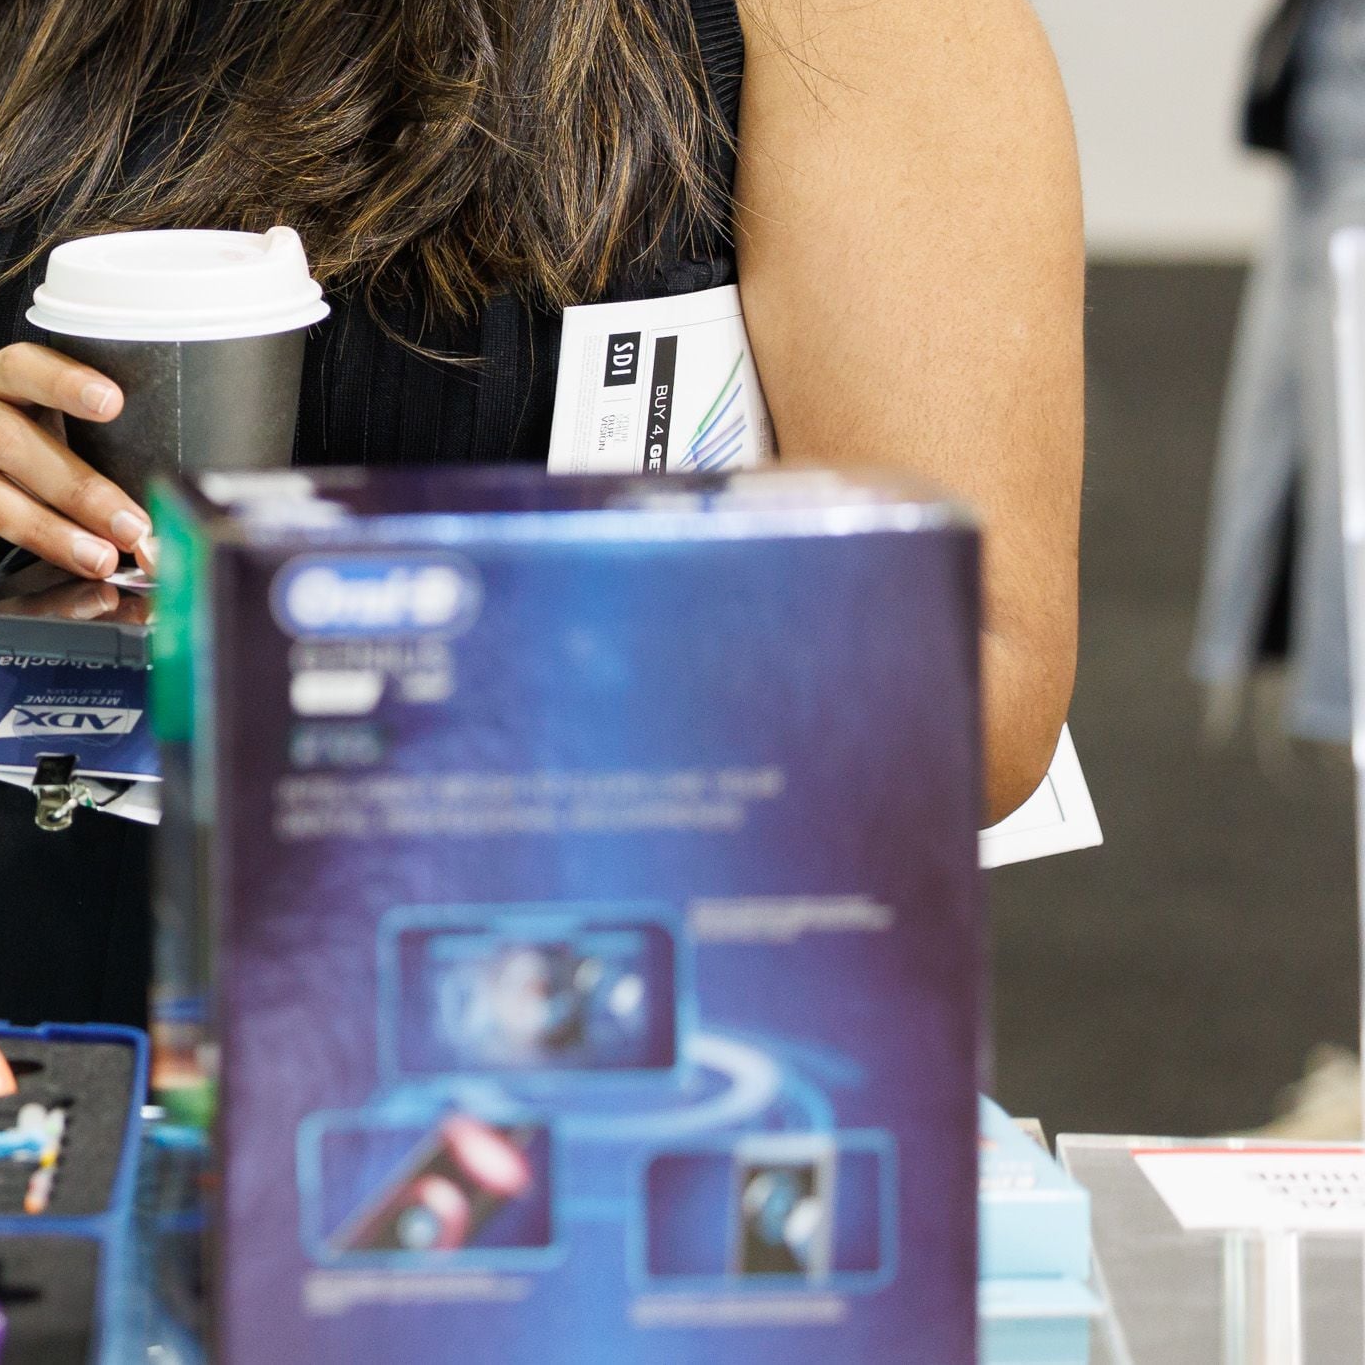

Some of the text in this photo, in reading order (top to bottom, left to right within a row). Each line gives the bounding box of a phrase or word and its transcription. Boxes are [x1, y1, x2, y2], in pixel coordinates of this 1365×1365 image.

[611, 341, 635, 376] SDI
[598, 416, 608, 452] VISION
[648, 385, 668, 475] BUY 4, GE
[22, 694, 122, 706] MELBOURNE
[12, 707, 123, 730] ADX
